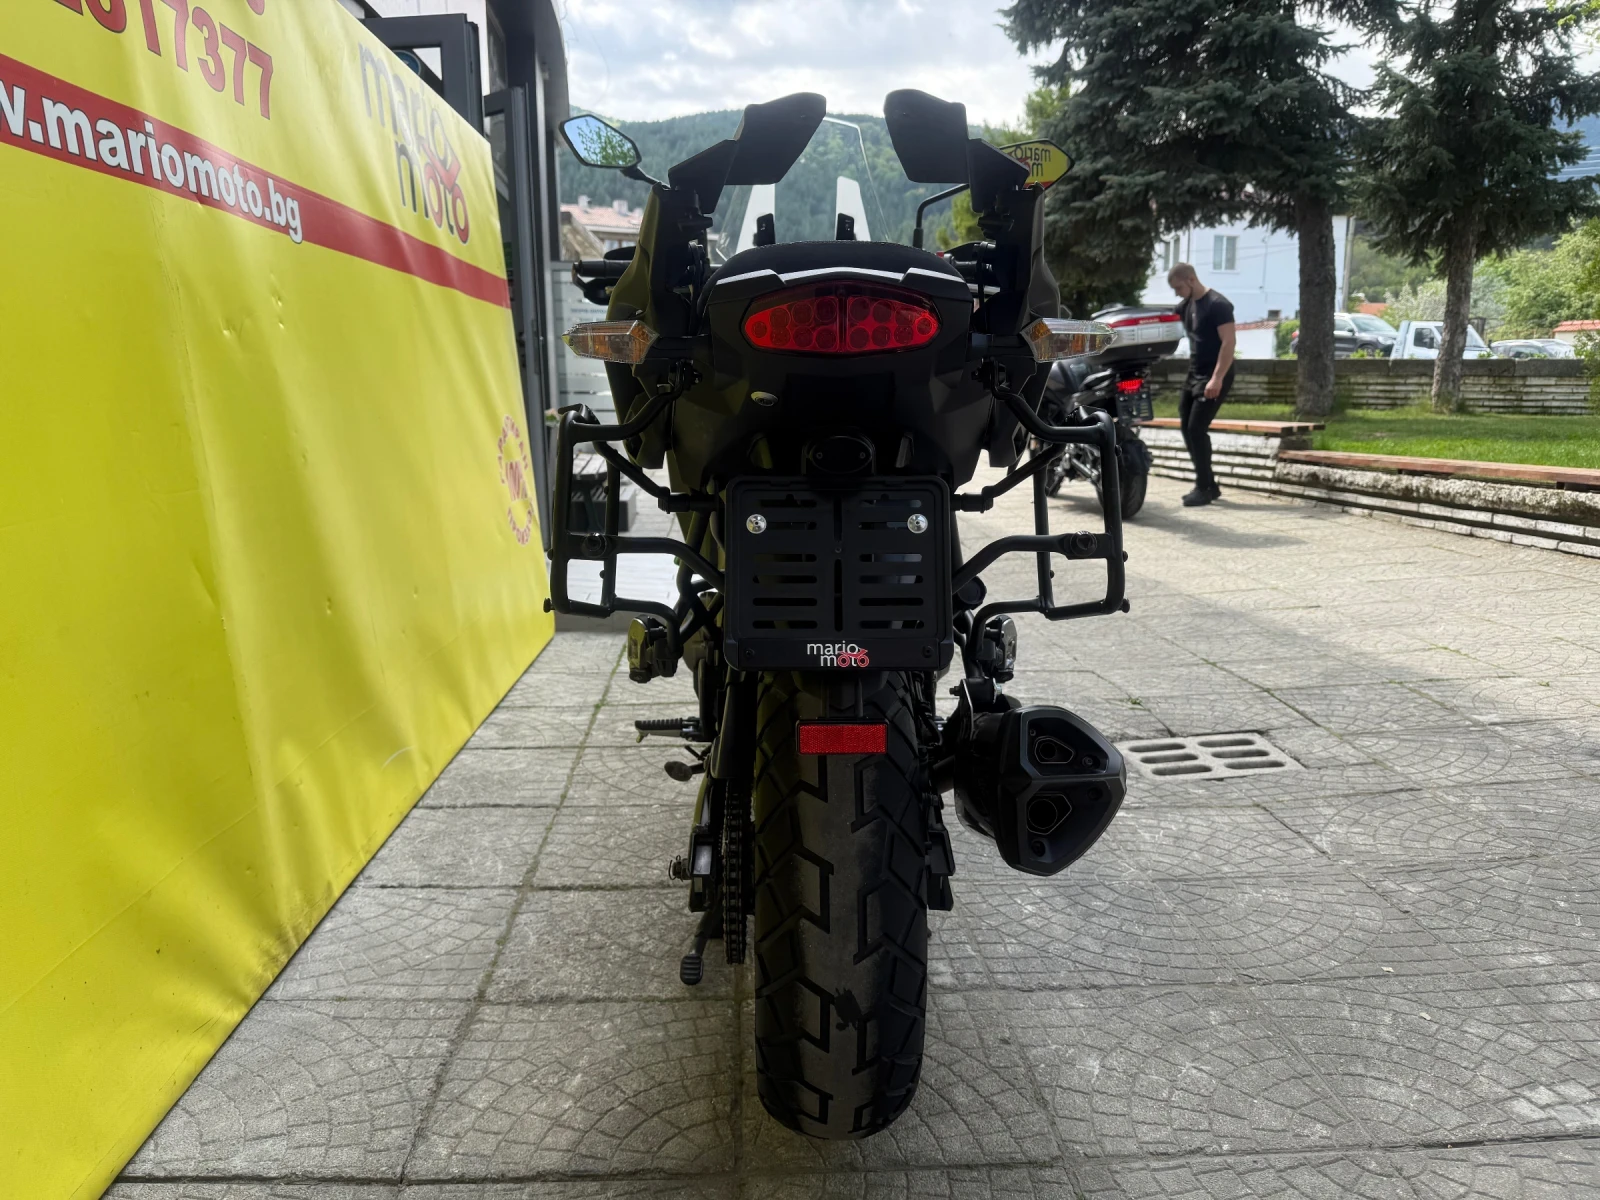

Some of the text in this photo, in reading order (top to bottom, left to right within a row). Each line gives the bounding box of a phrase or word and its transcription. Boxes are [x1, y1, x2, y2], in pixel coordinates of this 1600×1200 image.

[54, 0, 273, 120] 17377
[358, 42, 450, 167] mario
[395, 141, 470, 244] moto
[806, 640, 859, 655] mario
[820, 654, 870, 668] moto
